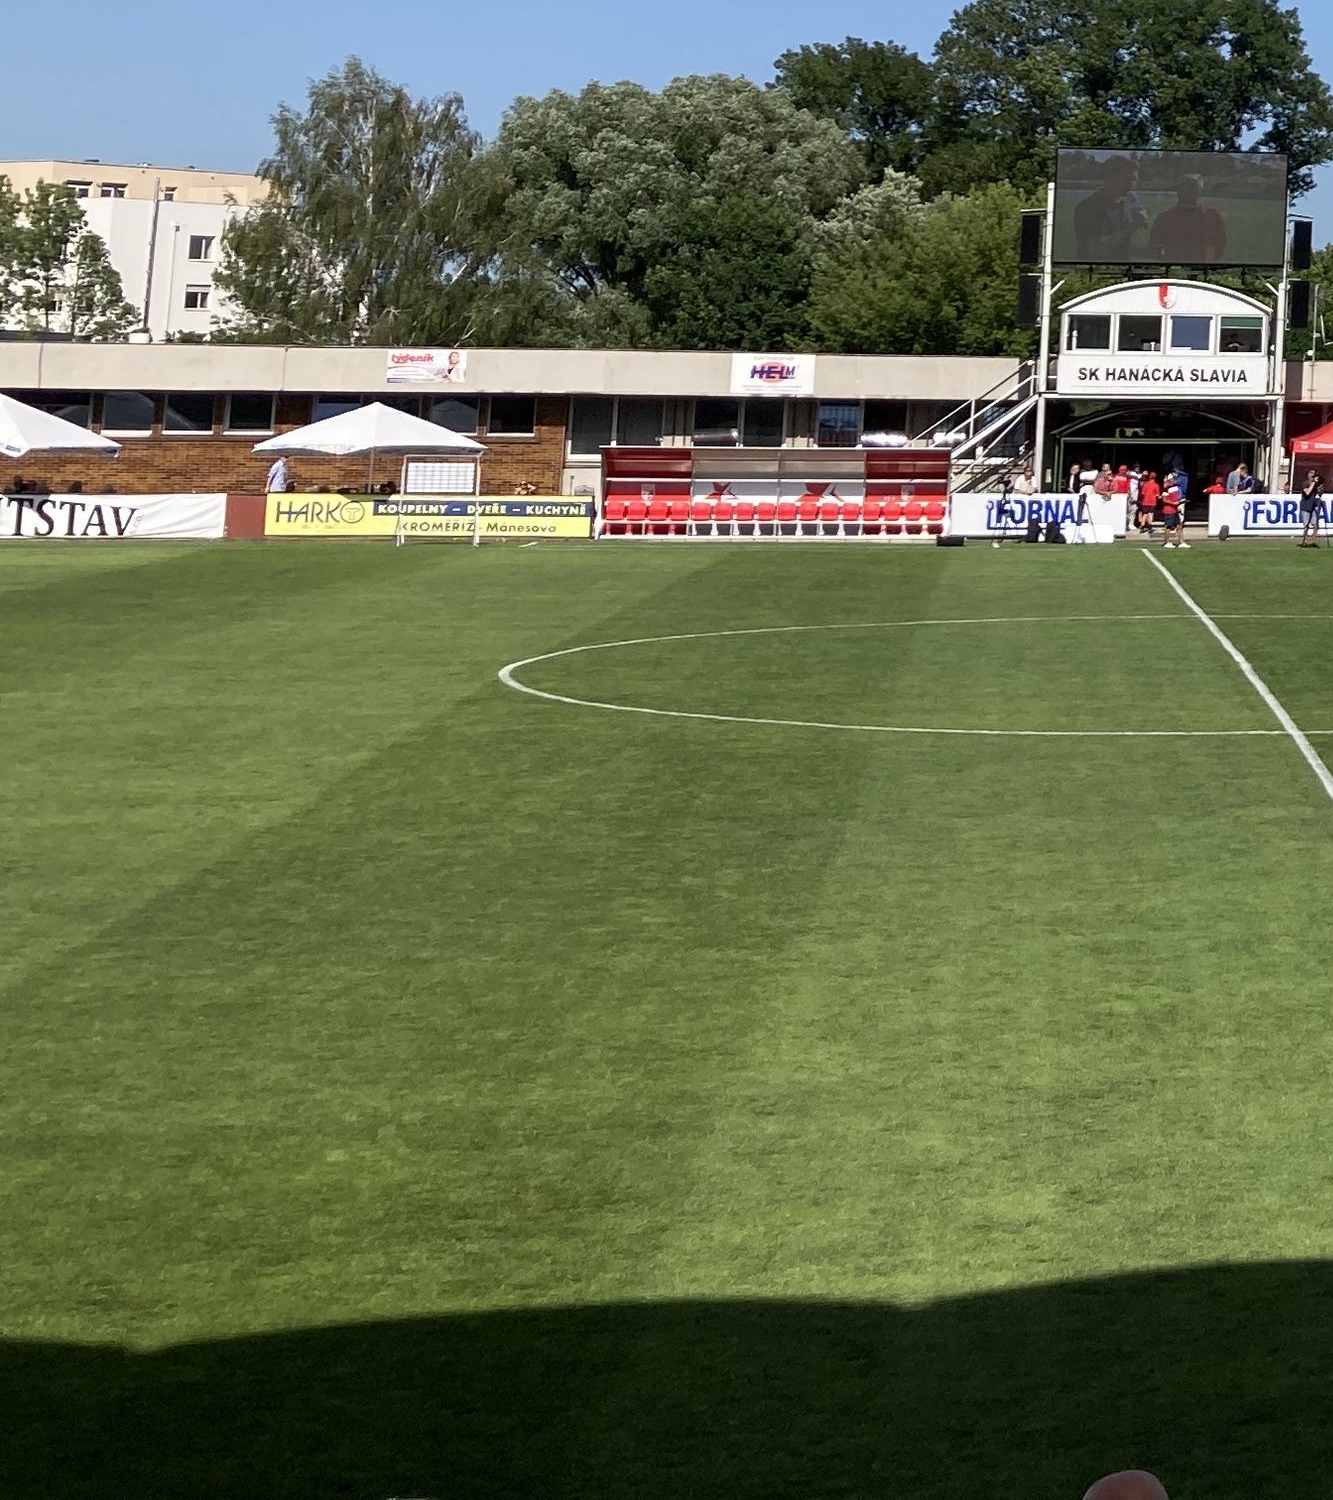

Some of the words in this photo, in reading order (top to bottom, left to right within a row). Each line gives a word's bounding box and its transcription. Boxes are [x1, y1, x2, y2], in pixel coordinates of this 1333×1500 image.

[750, 365, 796, 379] HELM
[1077, 367, 1100, 381] SK
[1105, 364, 1184, 382] HANÁCKÁ
[1190, 368, 1248, 383] SLAVIA
[377, 504, 448, 515] KOUPELNY
[466, 503, 507, 515] DVEŘE
[526, 502, 586, 516] KUCHYNĚ
[0, 496, 138, 537] TSTAV
[485, 521, 557, 533] Mánesova
